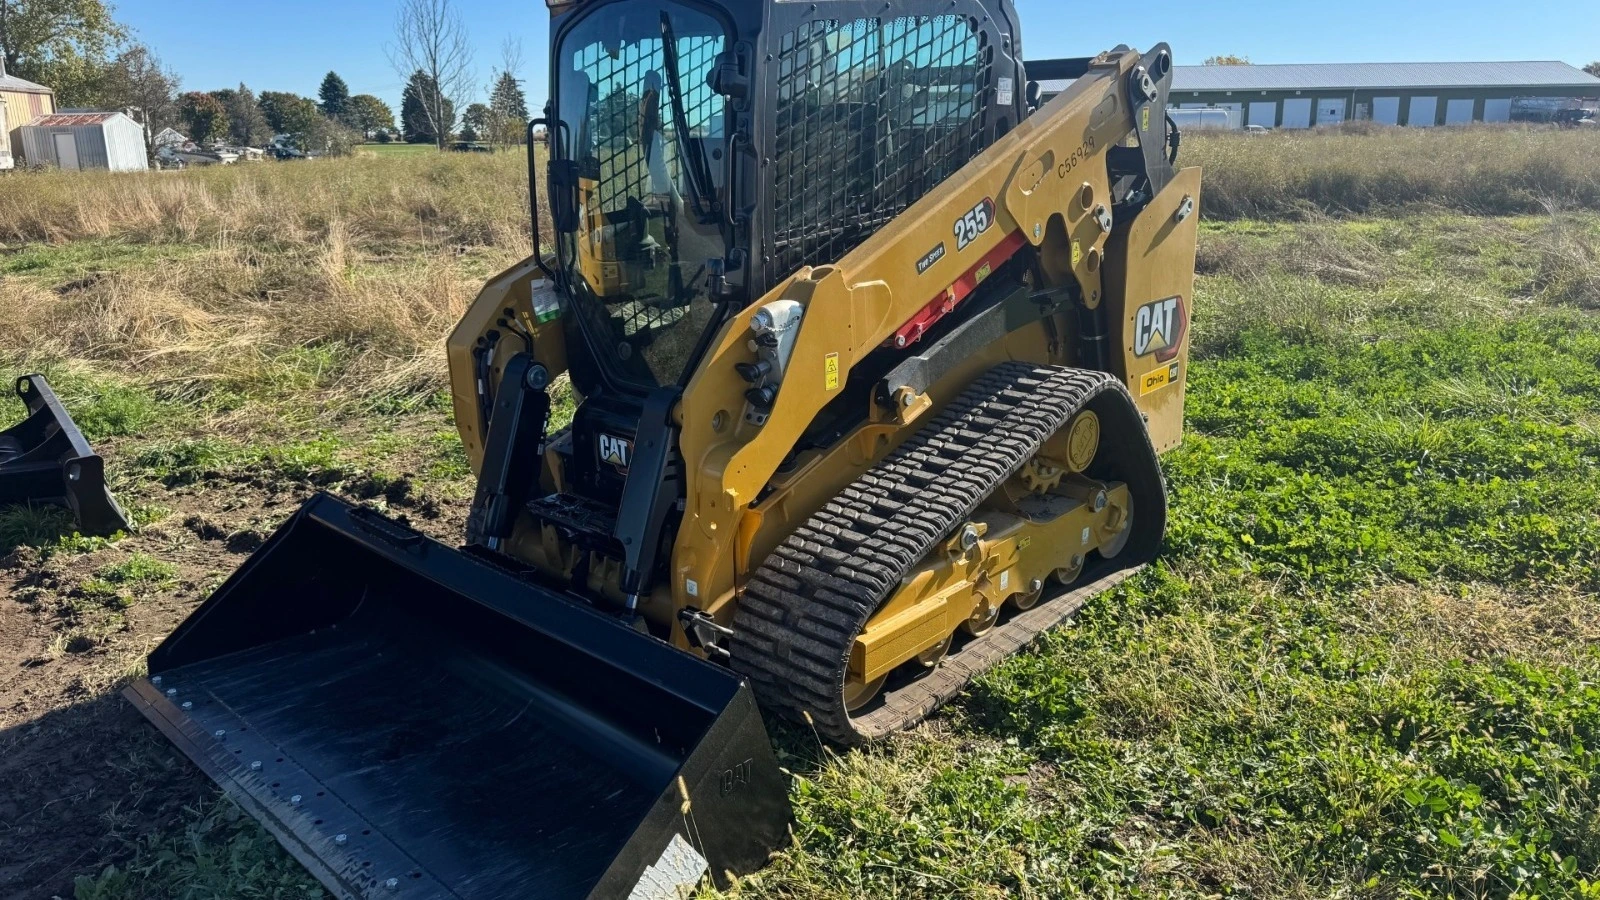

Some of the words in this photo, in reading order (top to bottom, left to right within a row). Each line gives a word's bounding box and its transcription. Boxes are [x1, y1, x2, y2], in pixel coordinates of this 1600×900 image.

[1058, 136, 1094, 178] C56929
[954, 203, 987, 250] 255
[1135, 298, 1177, 356] CAT
[1146, 375, 1164, 388] Ohio
[600, 434, 628, 466] CAT
[721, 757, 753, 795] CAT
